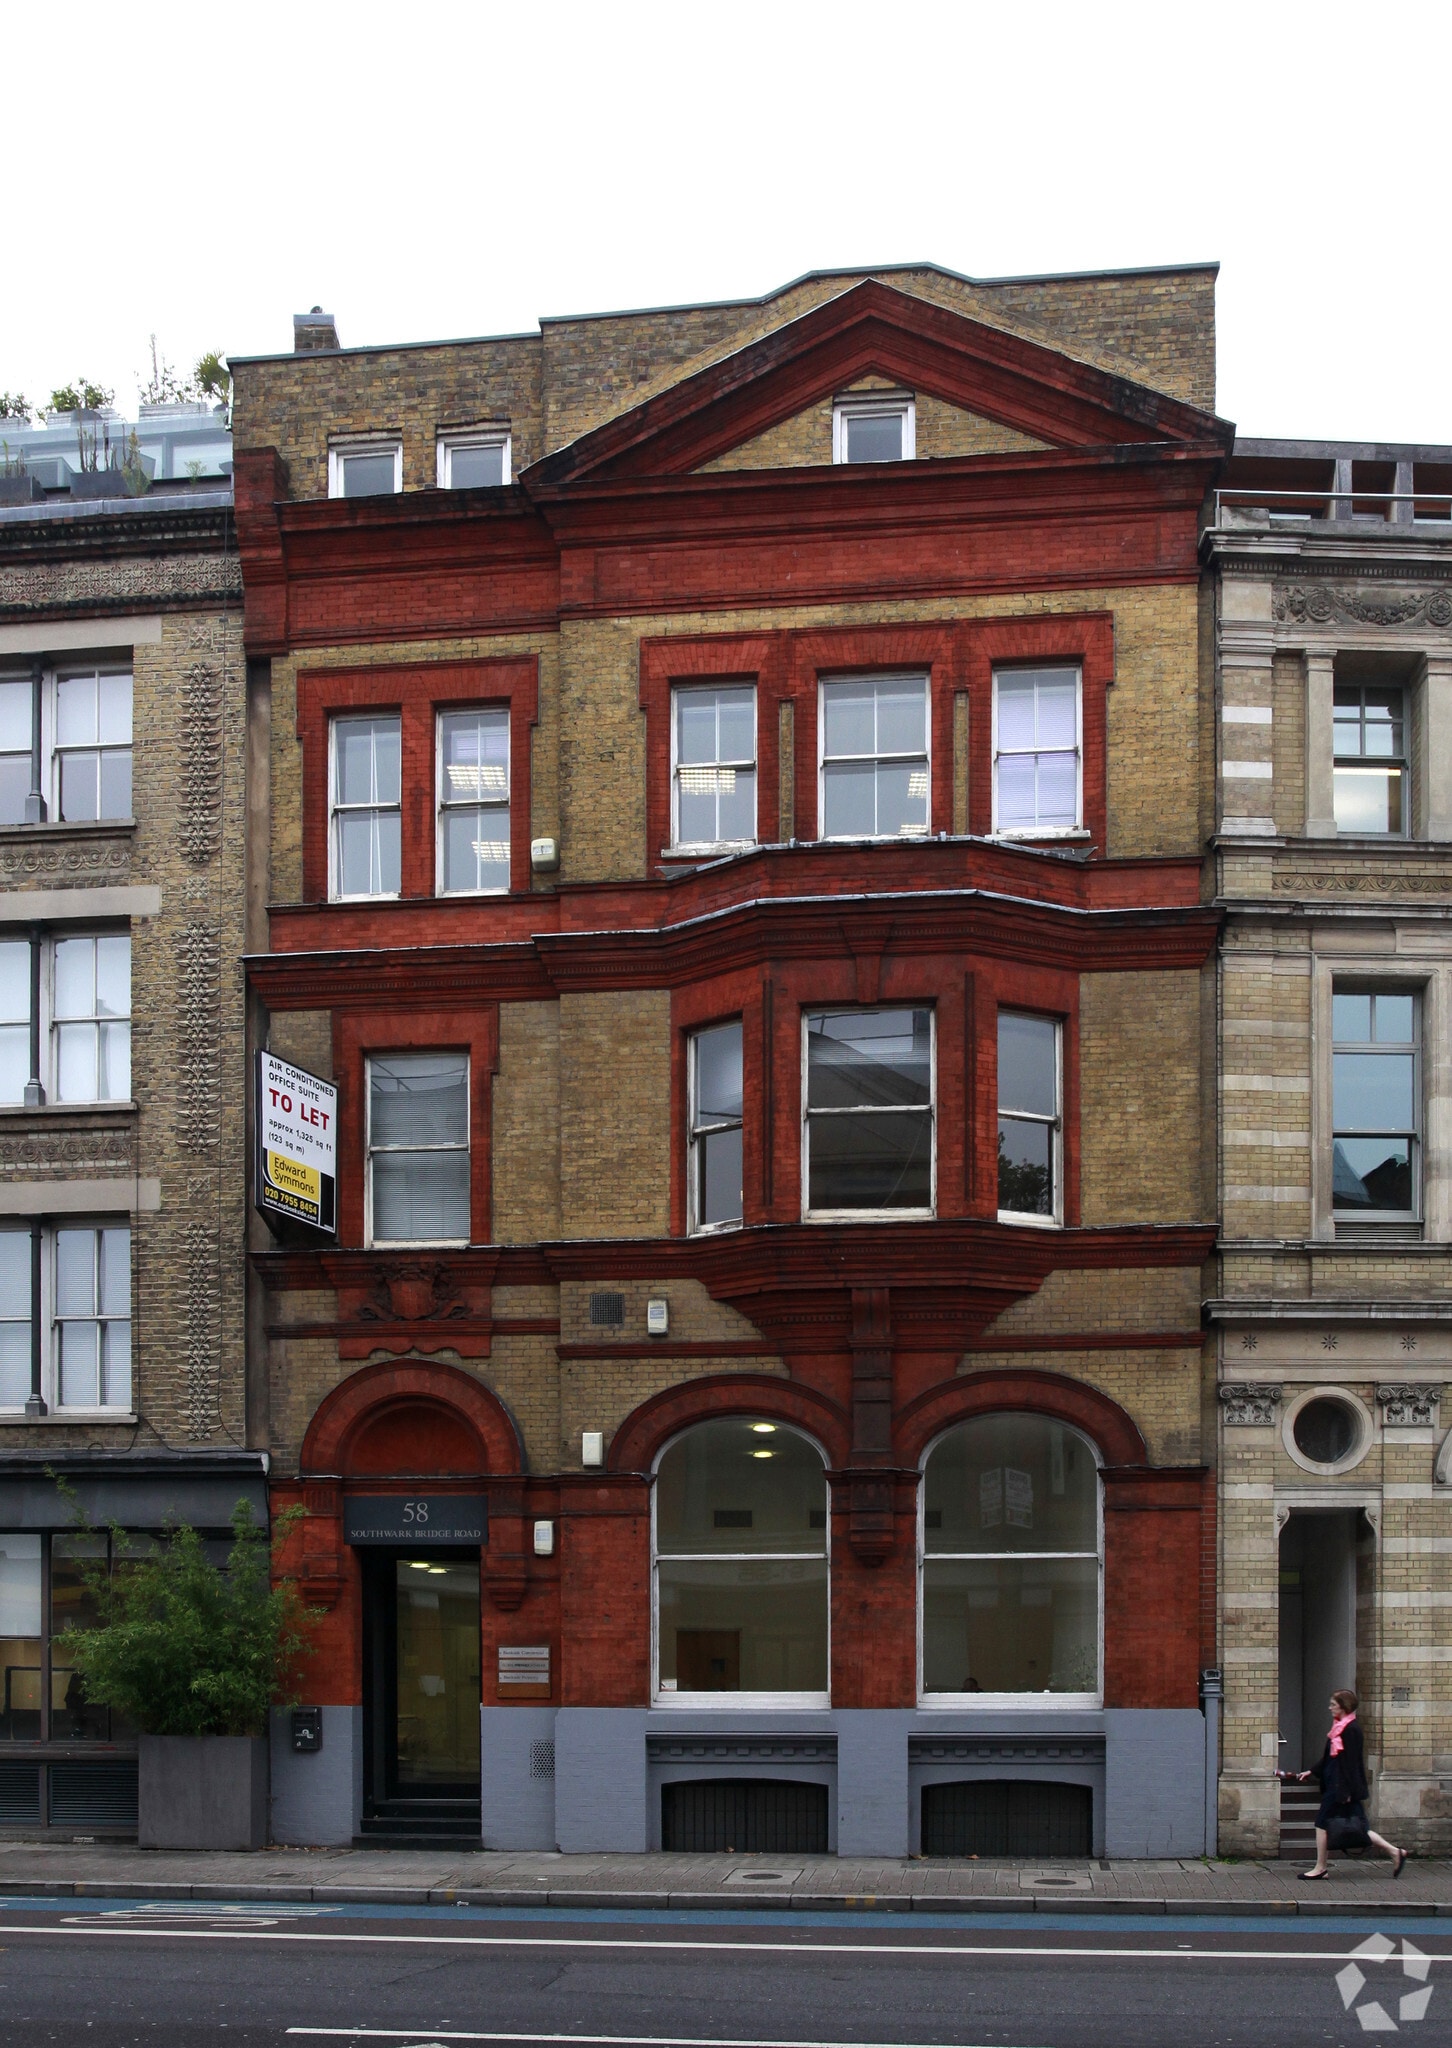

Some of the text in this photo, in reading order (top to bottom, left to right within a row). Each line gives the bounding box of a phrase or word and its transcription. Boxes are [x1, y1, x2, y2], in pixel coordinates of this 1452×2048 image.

[269, 1060, 334, 1097] AIR CONDITIONED
[269, 1072, 320, 1102] OFFICE SUITE
[269, 1088, 330, 1130] TO LET
[269, 1118, 332, 1152] approx 1,325 sq ft
[269, 1132, 305, 1155] (123 sq m)
[274, 1157, 306, 1179] Edward
[274, 1169, 315, 1194] Symmons
[264, 1186, 317, 1215] 020 7955 8454
[402, 1502, 429, 1523] 58
[351, 1530, 481, 1538] SOUTHWARK BRIDGE ROAD
